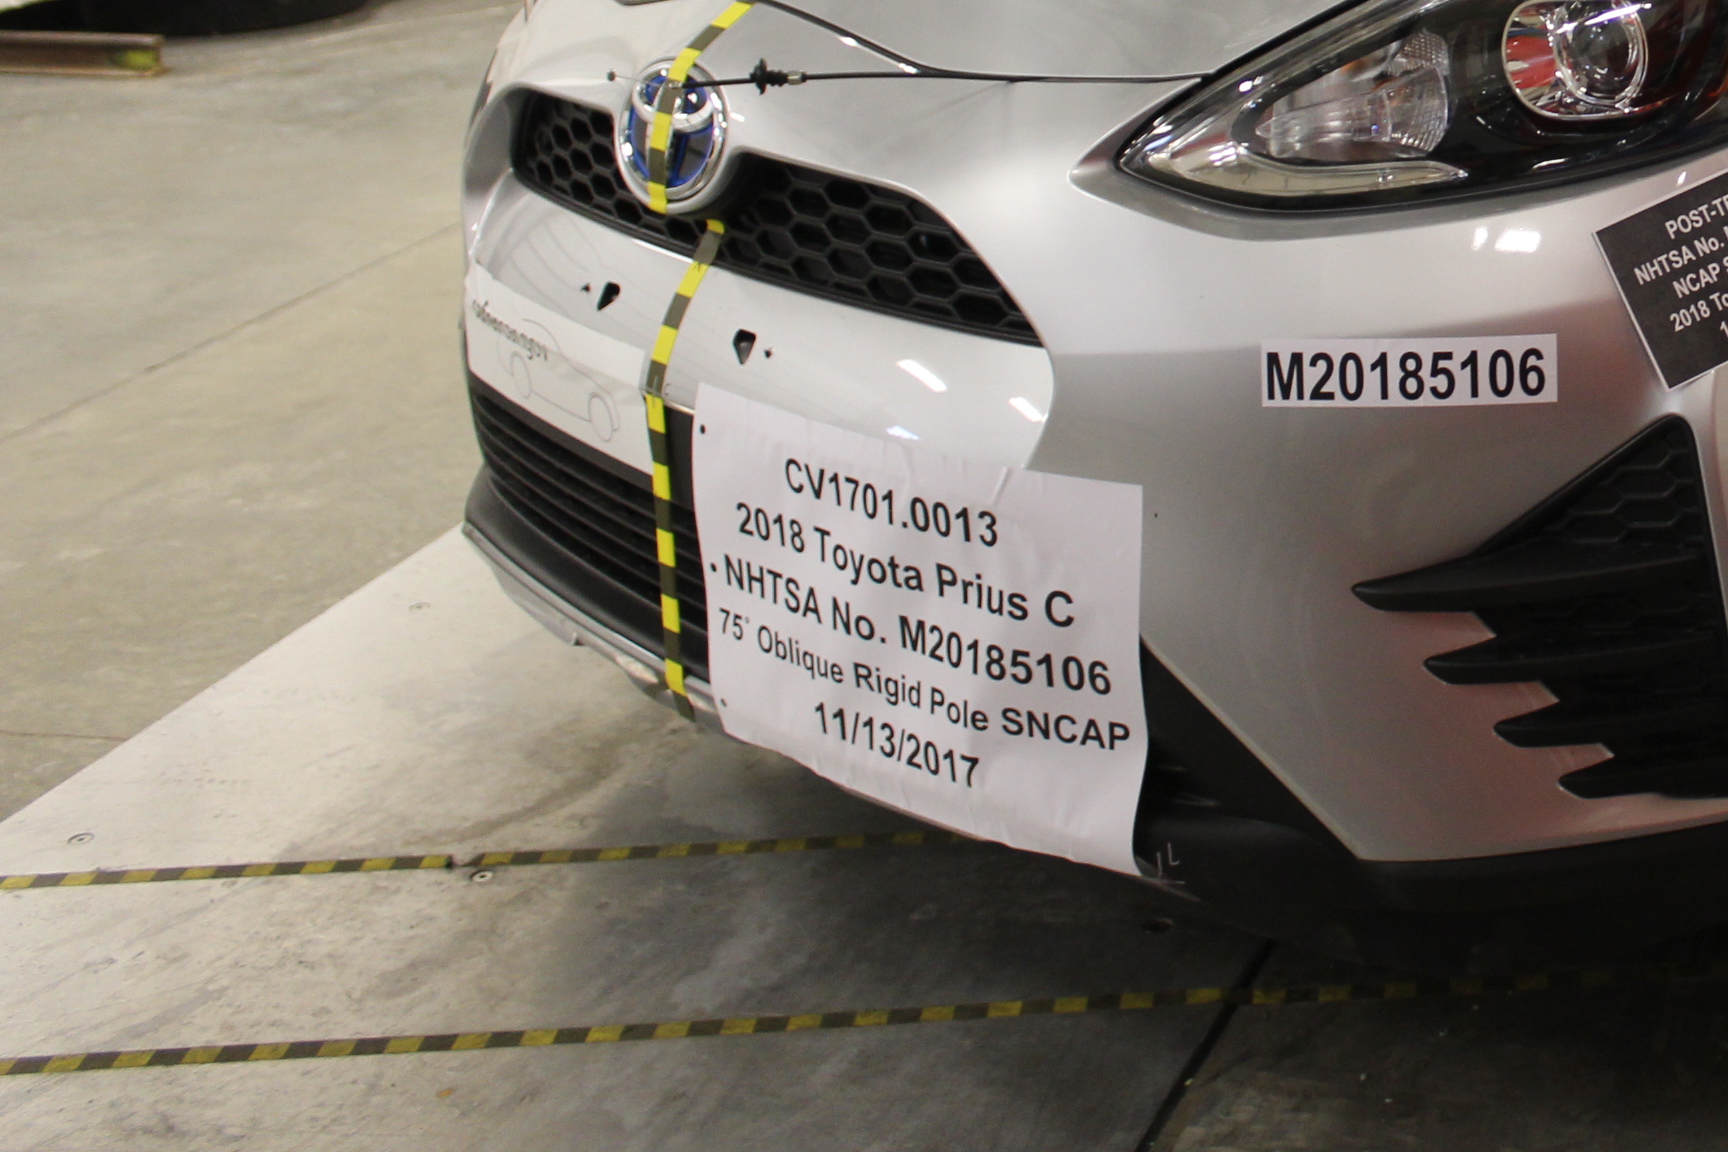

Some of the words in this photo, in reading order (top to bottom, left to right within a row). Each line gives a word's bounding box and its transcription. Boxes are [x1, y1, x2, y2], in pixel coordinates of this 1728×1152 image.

[1634, 246, 1696, 284] NHTSA
[1694, 238, 1724, 256] No.
[1673, 263, 1720, 297] NCAP
[1670, 300, 1710, 331] 2018
[1267, 348, 1545, 401] M20185106
[786, 459, 997, 547] CV1701.0013
[737, 503, 804, 553] 2018
[814, 527, 923, 592] Toyota
[936, 563, 1028, 621] Prius
[1045, 591, 1074, 627] C
[725, 555, 821, 623] NHTSA
[833, 598, 886, 643] No.
[899, 616, 1111, 695] M20185106
[758, 625, 843, 684] Oblique
[853, 662, 920, 707] Rigid
[931, 687, 989, 731] Pole
[1002, 708, 1130, 750] SNCAP
[816, 703, 979, 787] 11/13/2017
